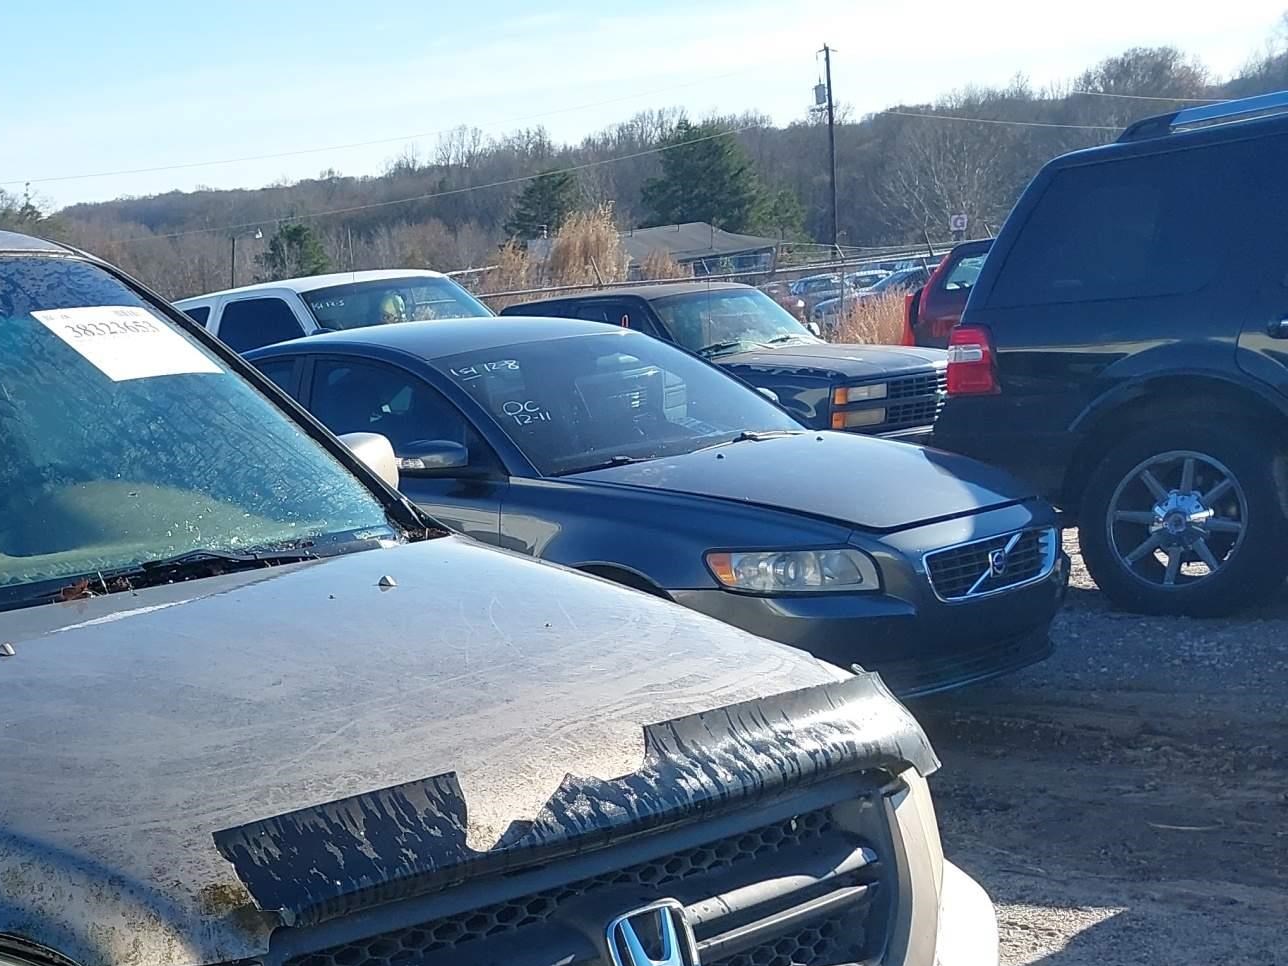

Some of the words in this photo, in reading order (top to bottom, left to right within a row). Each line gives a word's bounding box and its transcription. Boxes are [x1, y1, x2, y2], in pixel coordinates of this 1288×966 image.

[65, 321, 160, 338] 38323653
[483, 360, 520, 371] 12-8
[513, 411, 552, 426] 12-11
